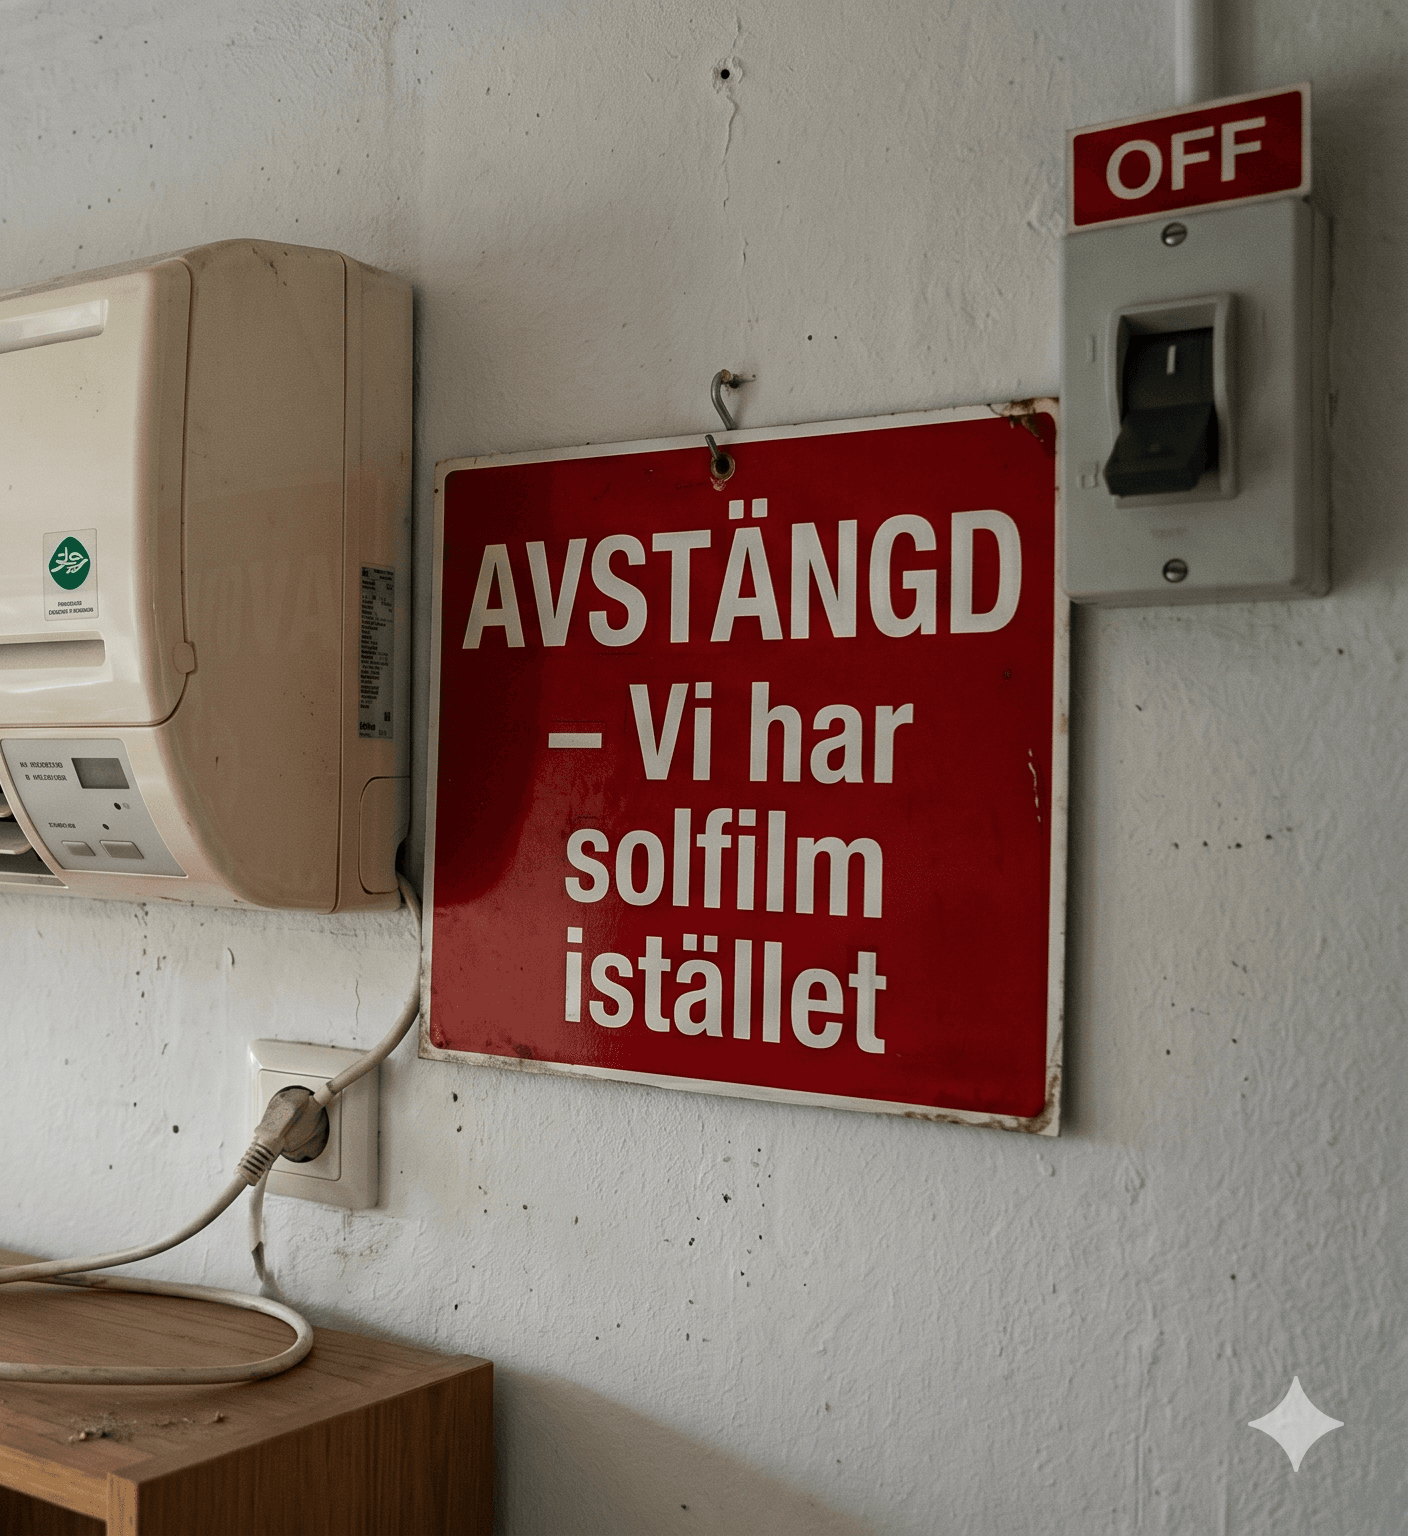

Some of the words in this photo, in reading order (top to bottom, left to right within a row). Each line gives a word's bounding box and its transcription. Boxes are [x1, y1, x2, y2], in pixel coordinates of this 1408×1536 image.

[1106, 116, 1267, 200] OFF
[462, 497, 1022, 650] AVSTÄNGD
[629, 682, 713, 783] Vi
[749, 681, 914, 785] har
[564, 807, 884, 919] solfilm
[564, 926, 887, 1054] istället
